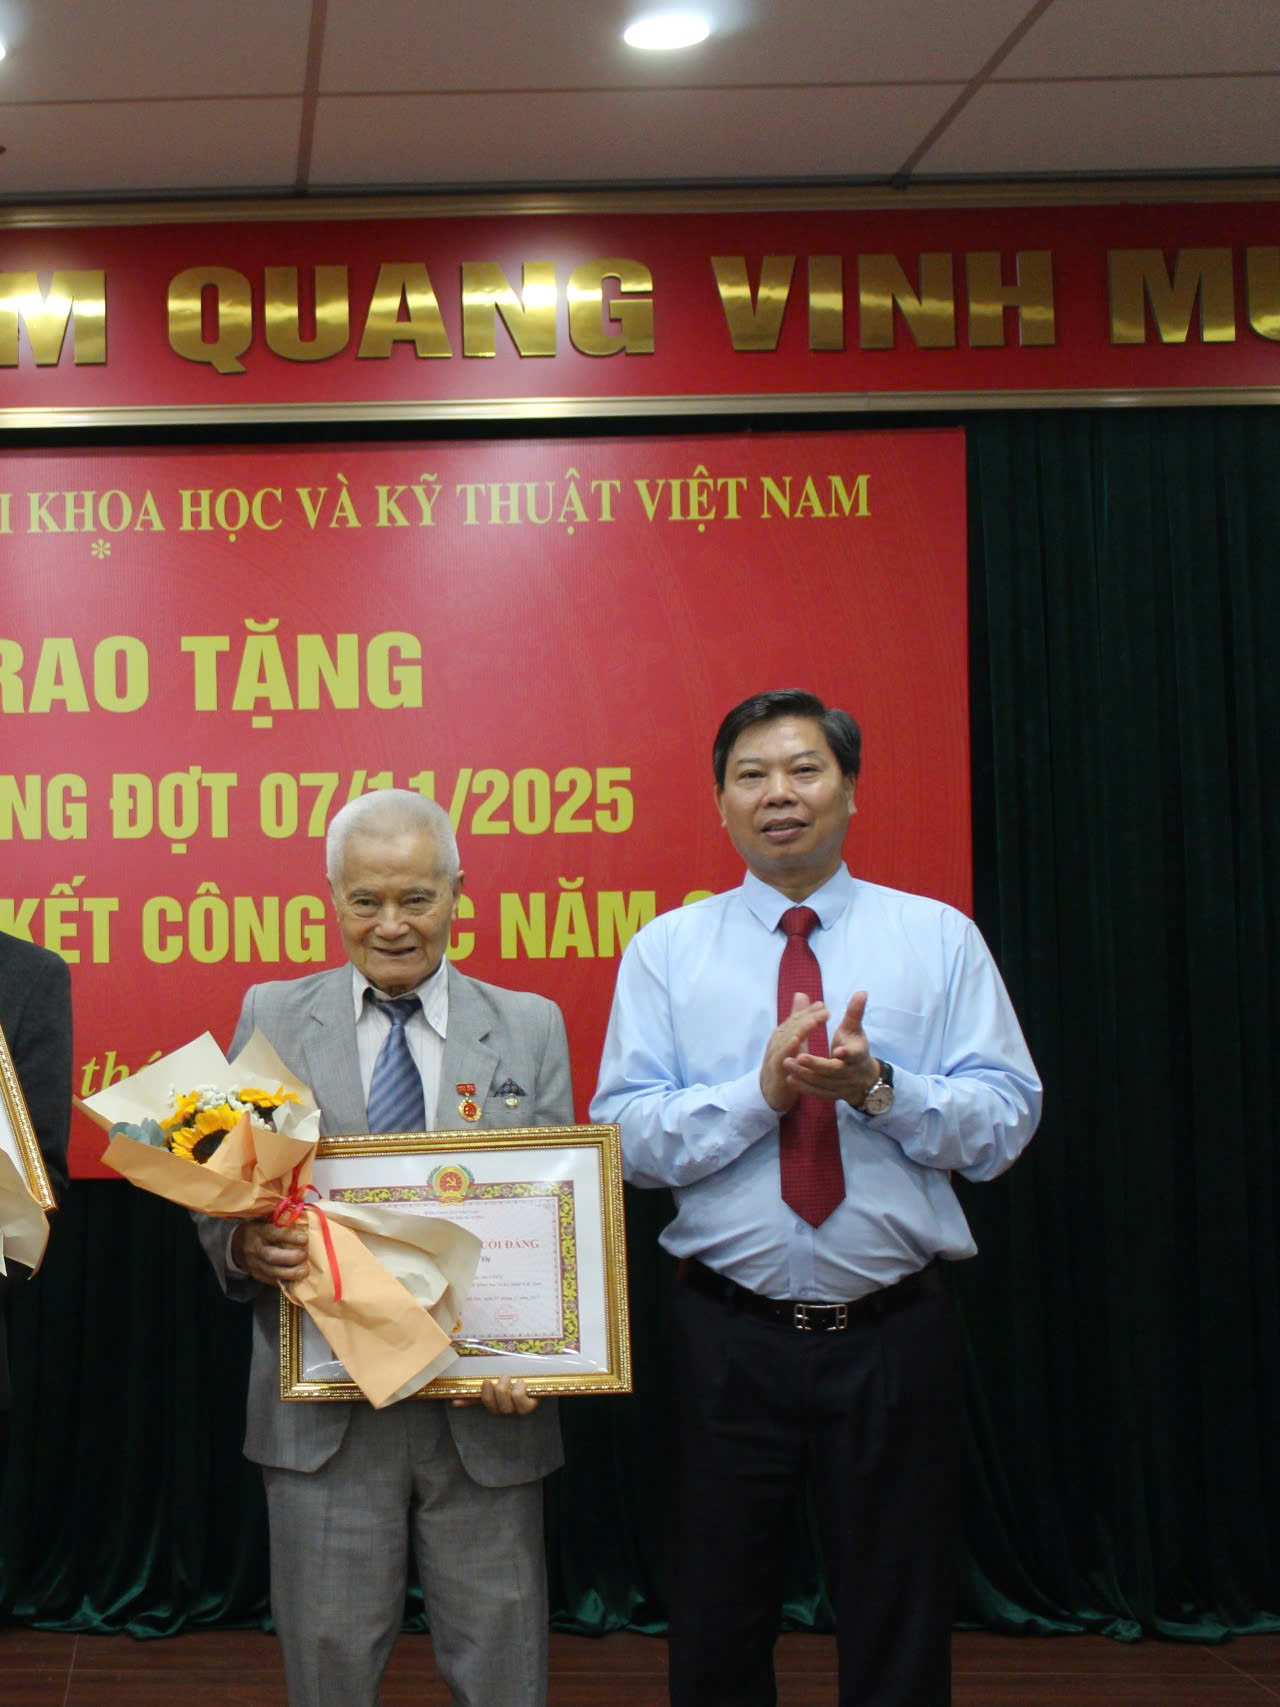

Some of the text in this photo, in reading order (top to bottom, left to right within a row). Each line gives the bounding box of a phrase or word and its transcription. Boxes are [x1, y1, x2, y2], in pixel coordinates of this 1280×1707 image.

[167, 256, 656, 374] QUANG
[710, 250, 1057, 352] VINH
[27, 490, 166, 534] KHOA
[178, 487, 283, 543] HỌC
[296, 473, 361, 529] VÀ
[375, 473, 441, 529] KỸ
[455, 468, 622, 535] THUẬT
[634, 465, 748, 533] VIỆT
[760, 475, 872, 520] NAM
[179, 617, 425, 730] TẶNG
[109, 764, 239, 855] ĐỢT
[259, 766, 635, 840] 07//2025
[141, 880, 327, 966] CÔNG
[499, 876, 657, 960] NĂM
